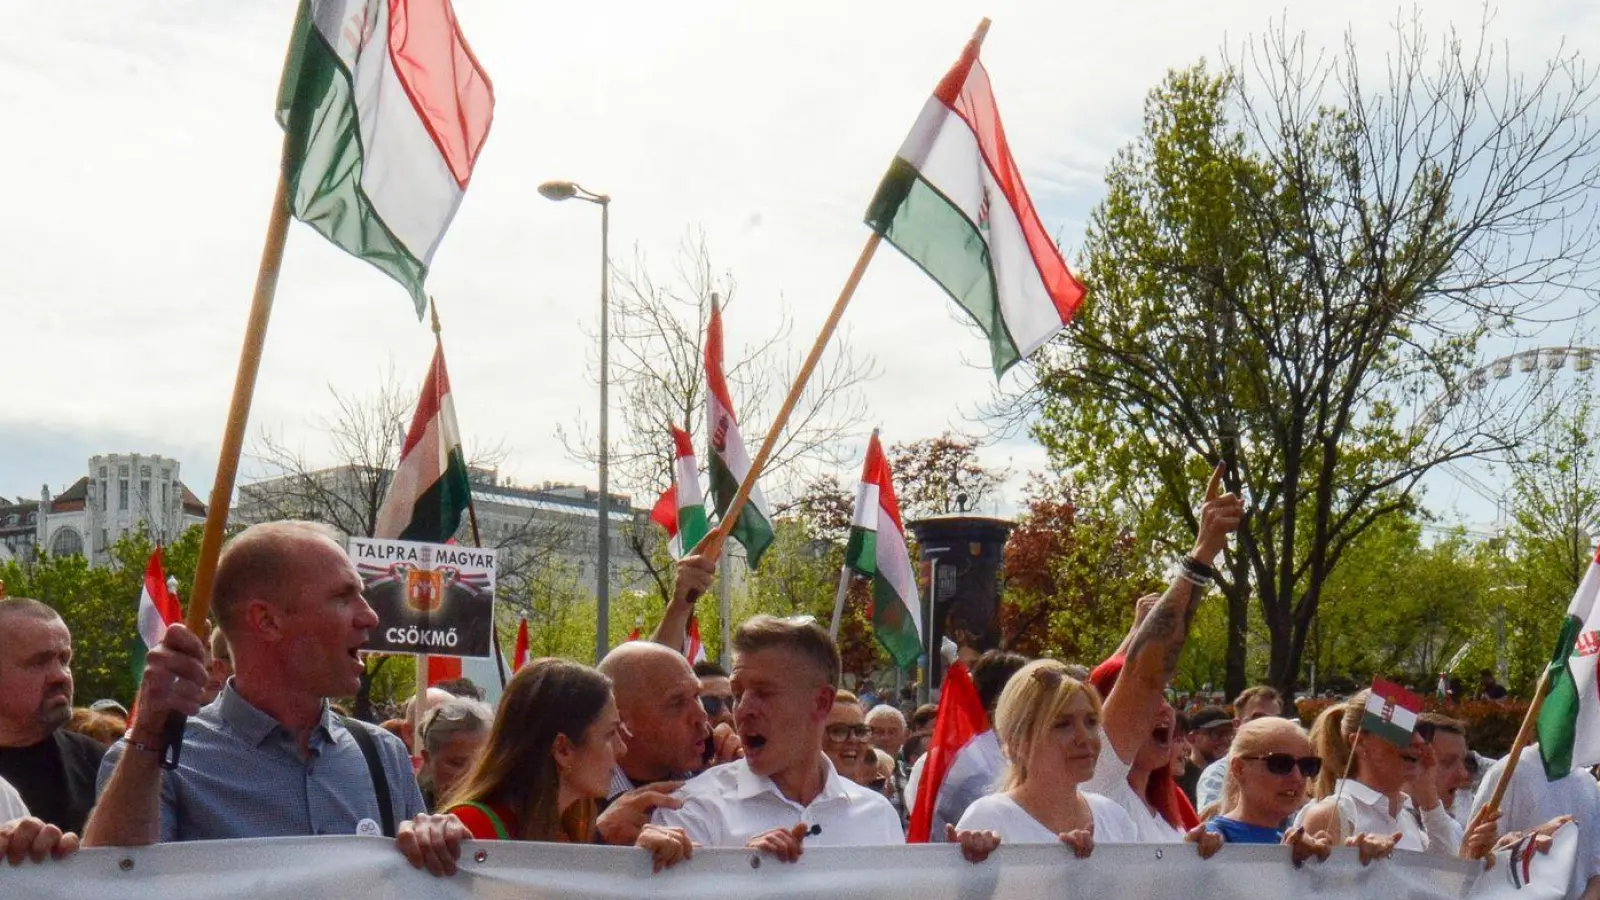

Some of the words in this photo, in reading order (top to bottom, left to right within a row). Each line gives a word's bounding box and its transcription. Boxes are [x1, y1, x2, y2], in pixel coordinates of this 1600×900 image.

[357, 543, 418, 561] TALPRA
[435, 549, 494, 568] MAGYAR
[386, 625, 458, 647] CSÖKMŐ
